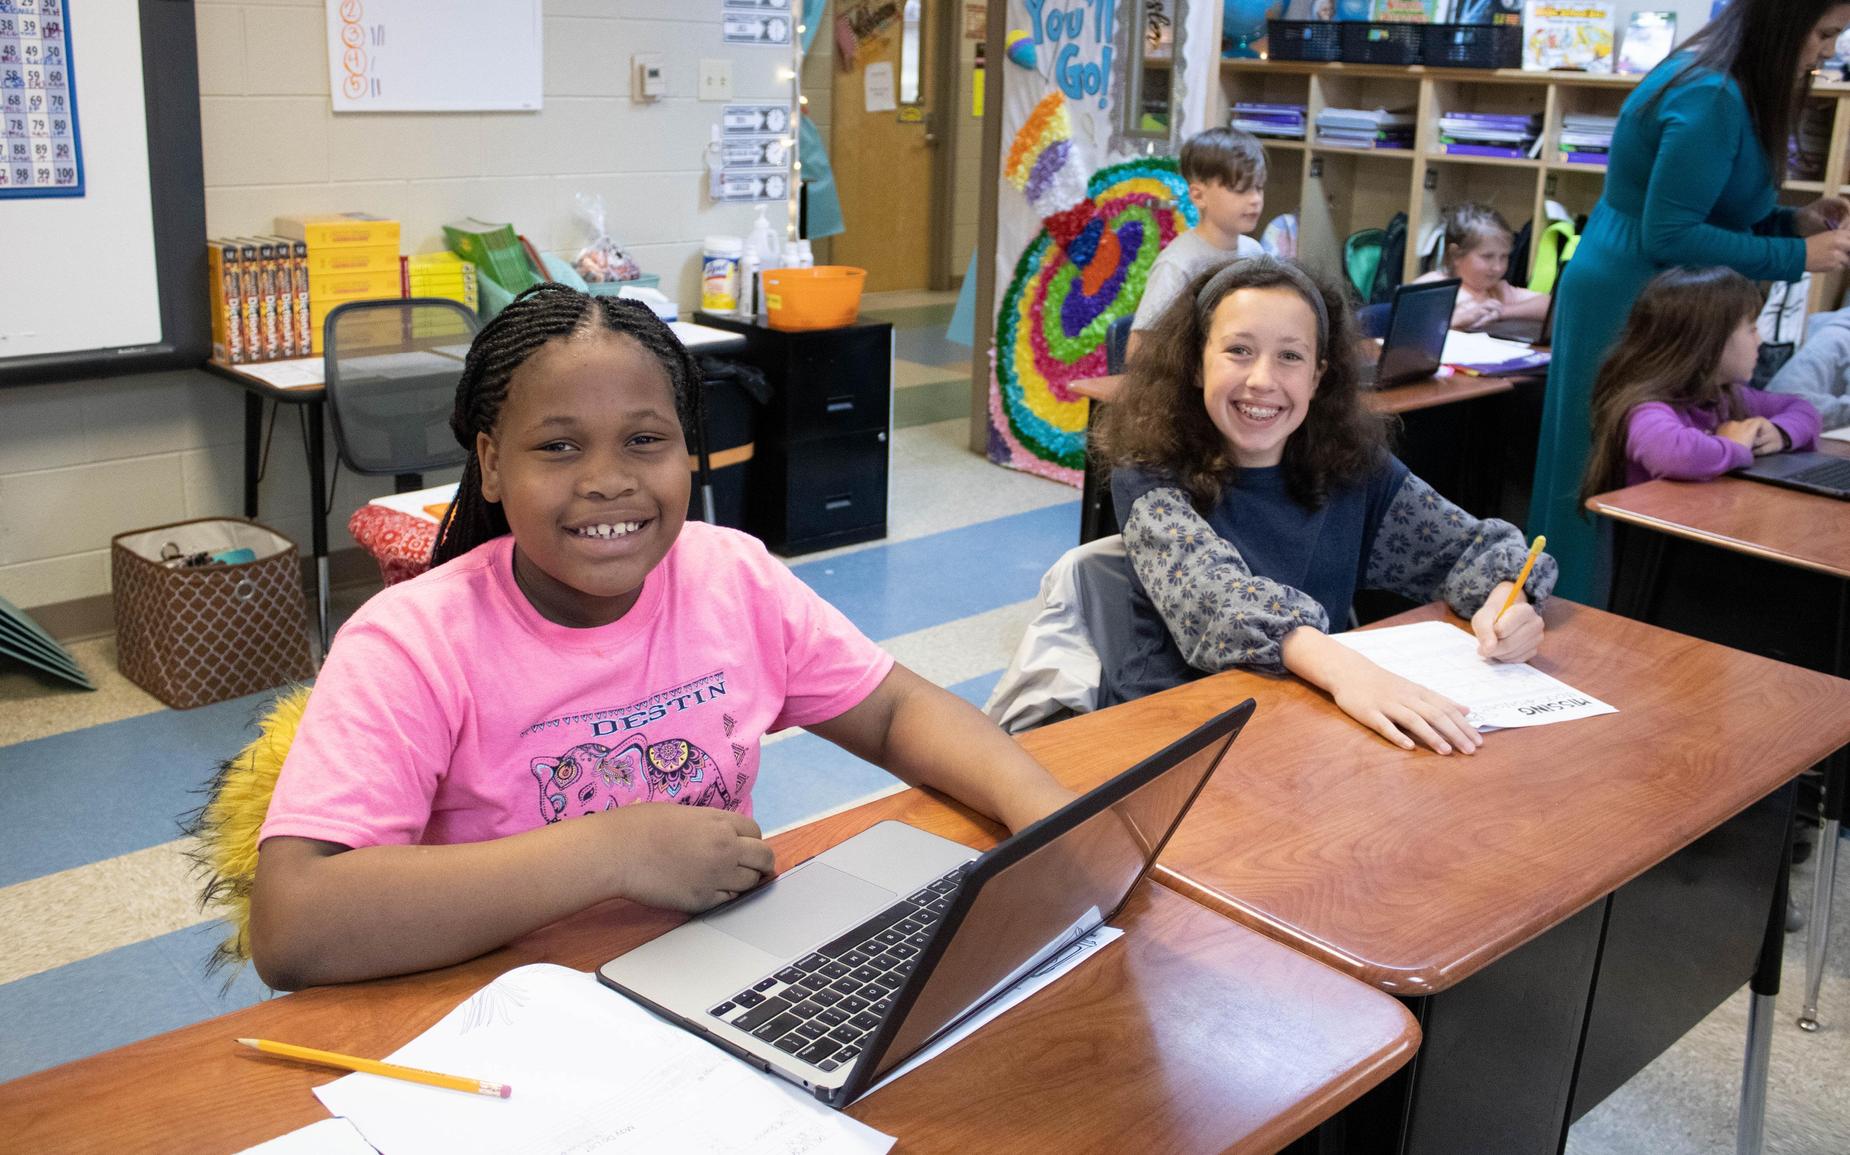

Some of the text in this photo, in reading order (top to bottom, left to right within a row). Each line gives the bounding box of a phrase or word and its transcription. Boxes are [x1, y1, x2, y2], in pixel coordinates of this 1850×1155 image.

[1, 20, 14, 31] 38
[24, 20, 36, 31] 39
[3, 45, 60, 57] 48 49 50
[6, 70, 62, 81] 58 59 60
[1055, 43, 1113, 109] Go!
[8, 95, 64, 106] 68 69 70
[10, 120, 66, 130] 78 79 80
[14, 144, 69, 154] 88 89 90
[16, 169, 29, 180] 98
[38, 169, 50, 179] 99
[57, 168, 74, 178] 100
[229, 298, 243, 353] Dictionary
[248, 296, 261, 350] Dictionary
[265, 294, 278, 350] Dictionary
[281, 292, 294, 347] Dictionary
[298, 292, 311, 346] Dictionary
[590, 681, 727, 737] DESTIN
[1517, 698, 1593, 716] MISSING
